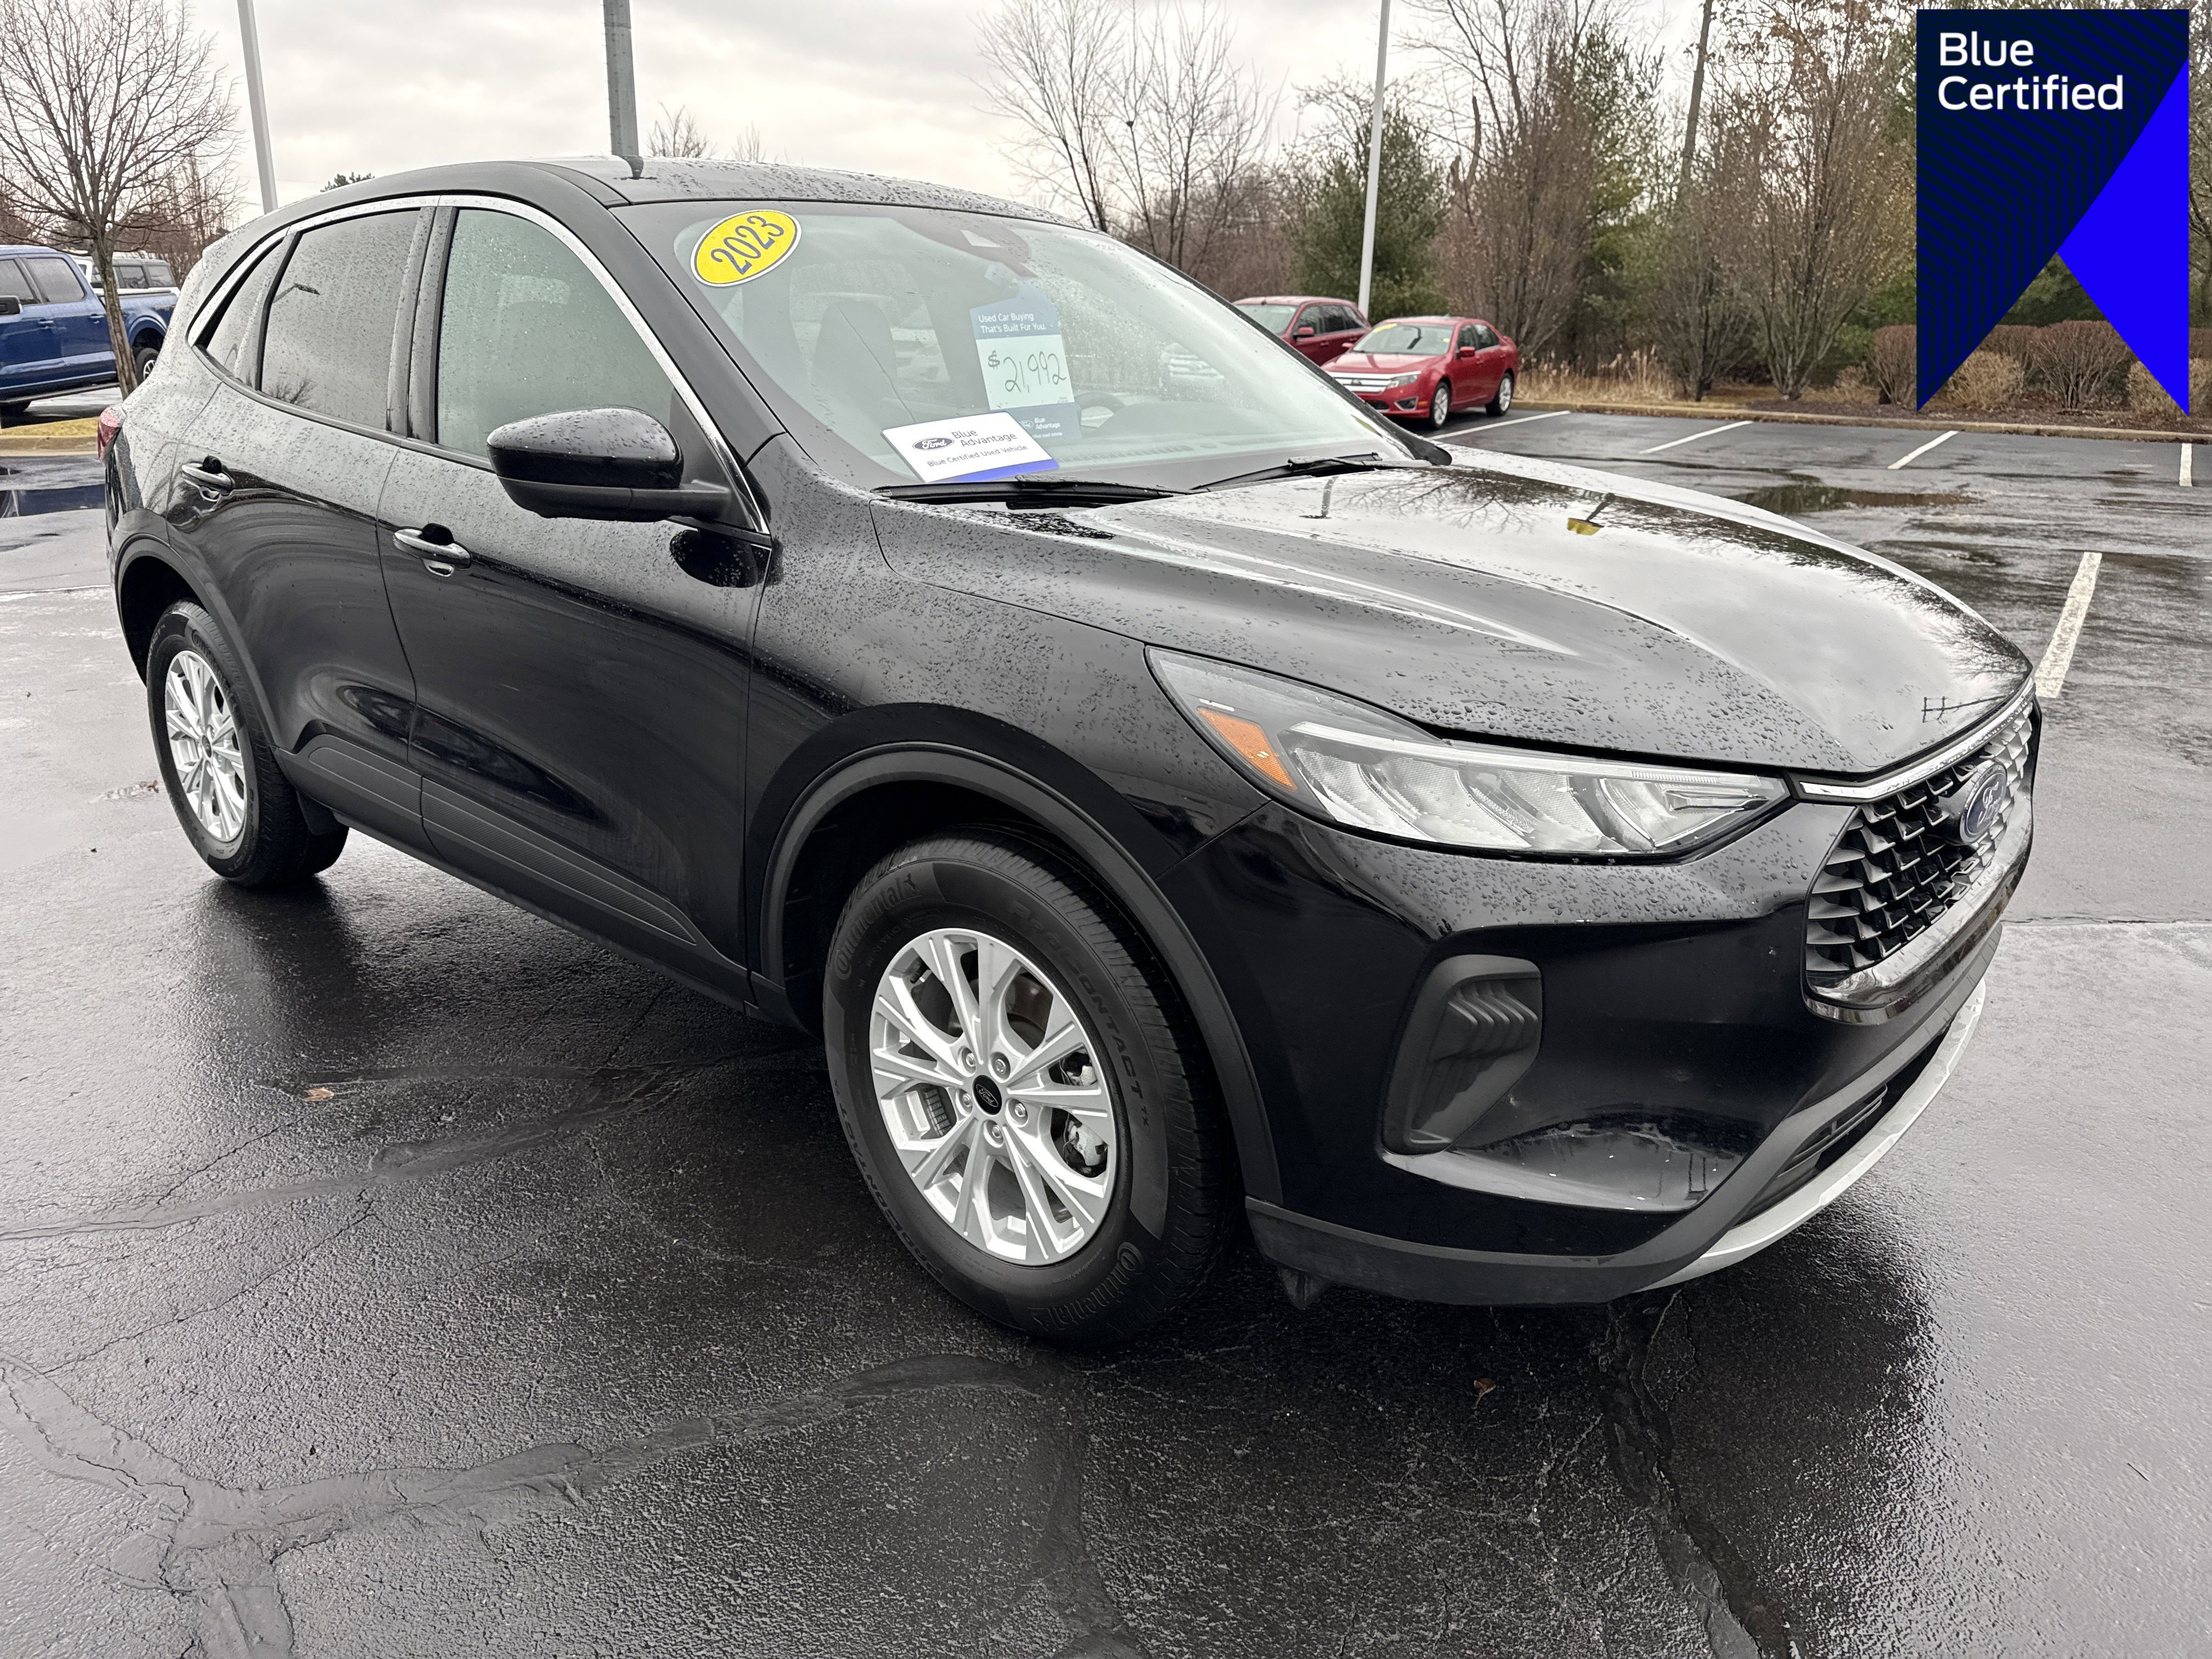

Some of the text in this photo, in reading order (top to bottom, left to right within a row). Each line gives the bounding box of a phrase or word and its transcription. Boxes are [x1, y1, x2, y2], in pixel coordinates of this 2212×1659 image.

[710, 215, 785, 275] 2023
[978, 313, 1034, 323] Used Car Buying
[980, 324, 1002, 334] That's
[1003, 324, 1020, 332] Built
[1003, 351, 1067, 393] 21,992
[951, 430, 979, 439] Blue
[960, 432, 1018, 447] Advantage
[921, 438, 949, 449] Ford
[927, 444, 1028, 467] Blue Certified Used Vehicle
[833, 876, 904, 980] Continental
